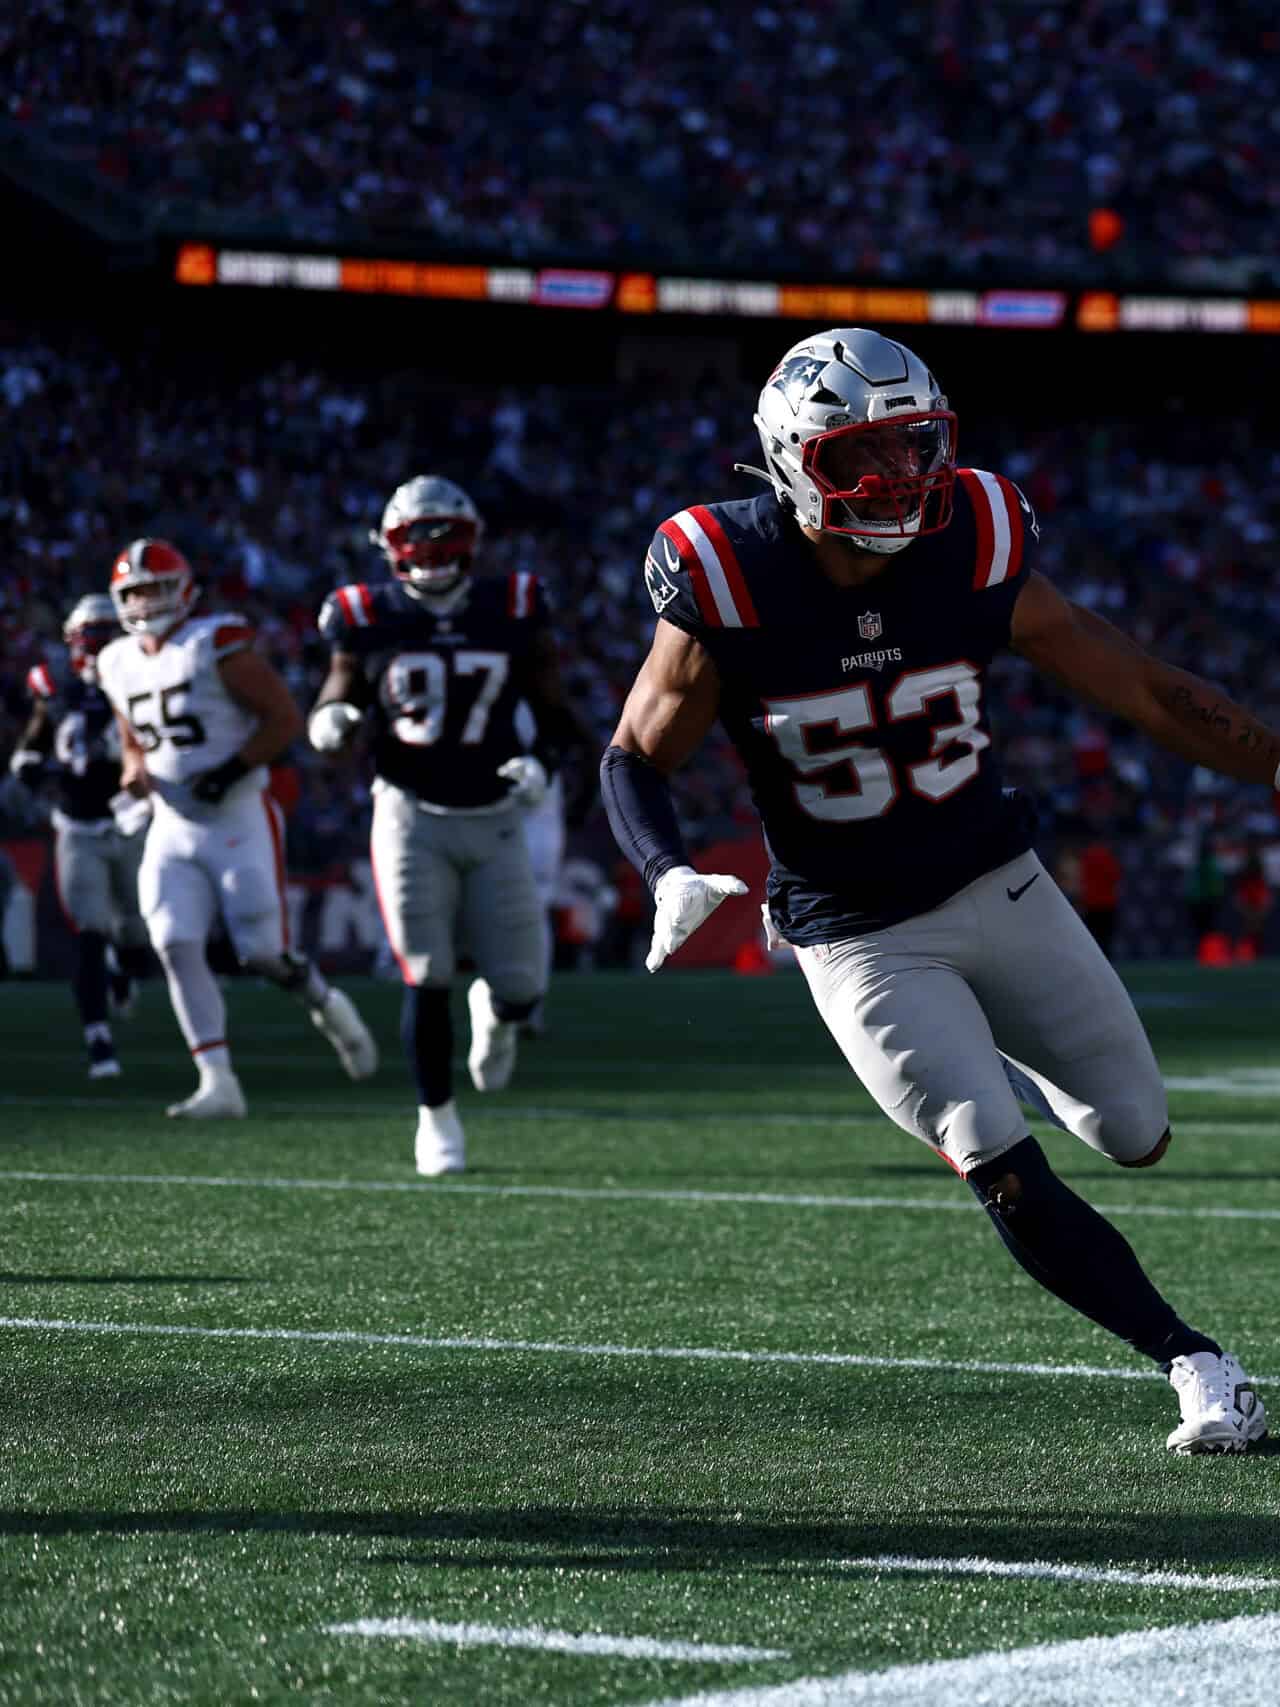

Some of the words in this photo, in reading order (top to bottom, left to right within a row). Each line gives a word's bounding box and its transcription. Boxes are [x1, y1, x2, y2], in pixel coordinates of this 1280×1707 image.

[386, 651, 509, 746] 97
[841, 647, 902, 672] PATRIOTS
[127, 681, 207, 752] 55
[758, 658, 991, 823] 53
